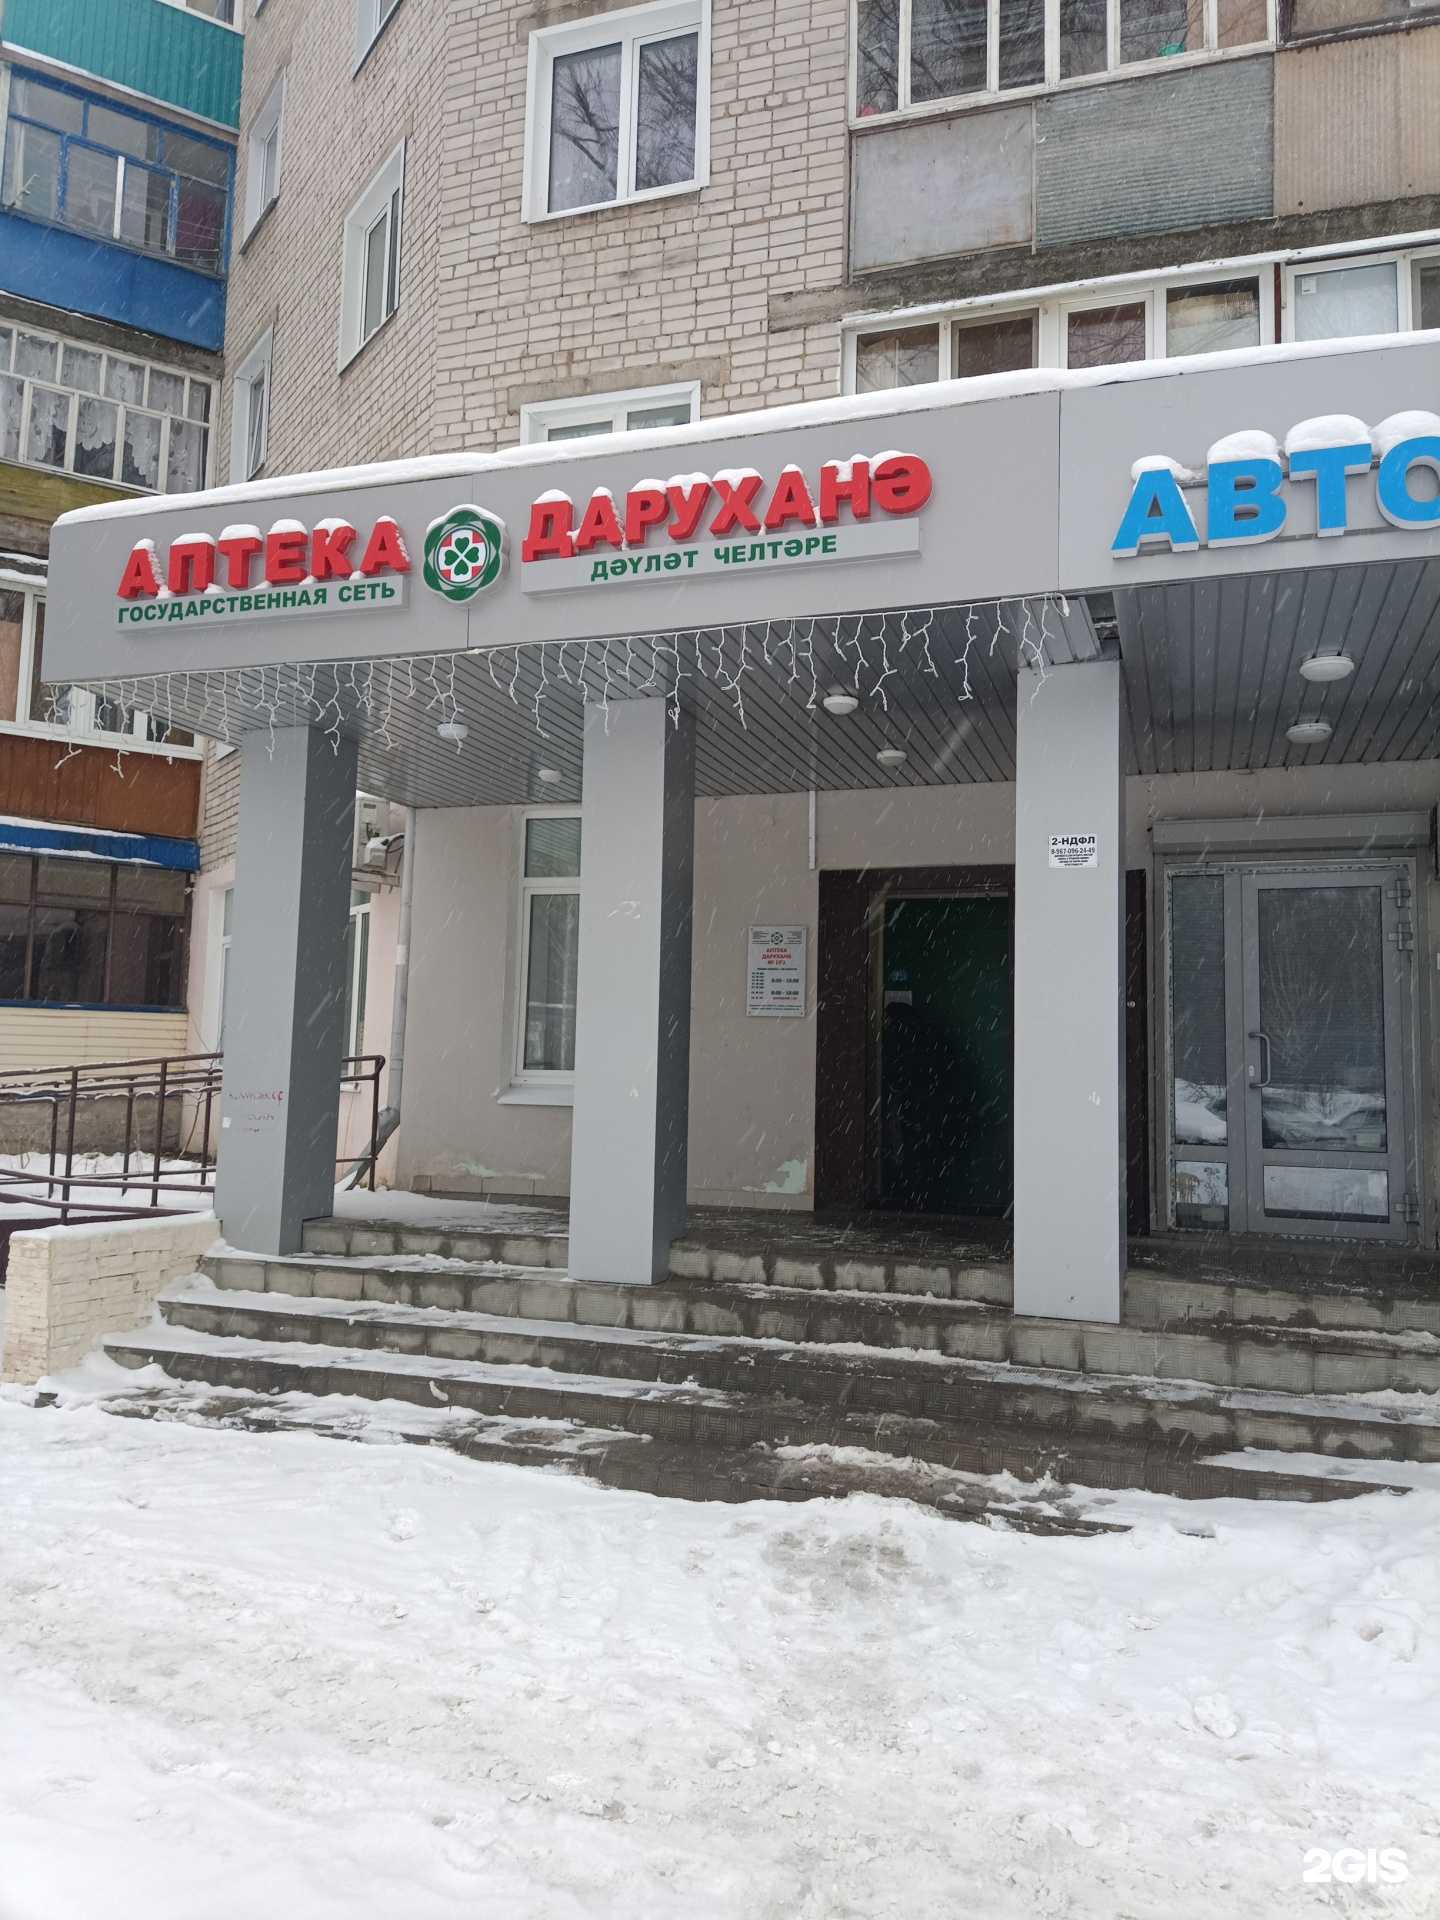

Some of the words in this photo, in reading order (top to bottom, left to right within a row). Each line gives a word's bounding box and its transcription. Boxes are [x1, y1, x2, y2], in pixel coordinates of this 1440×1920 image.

[521, 454, 934, 564] ДАРУХАНӘ
[1110, 434, 1440, 560] АВТО
[116, 519, 412, 600] АПТЕКА
[590, 550, 699, 582] ДӘҮЛӘТ
[714, 534, 837, 565] ЧЕЛТӘРЕ
[117, 588, 328, 624] ГОСУДАРСТВЕННАЯ
[338, 581, 396, 603] СЕТЬ
[1051, 836, 1095, 847] 2-НДФЛ
